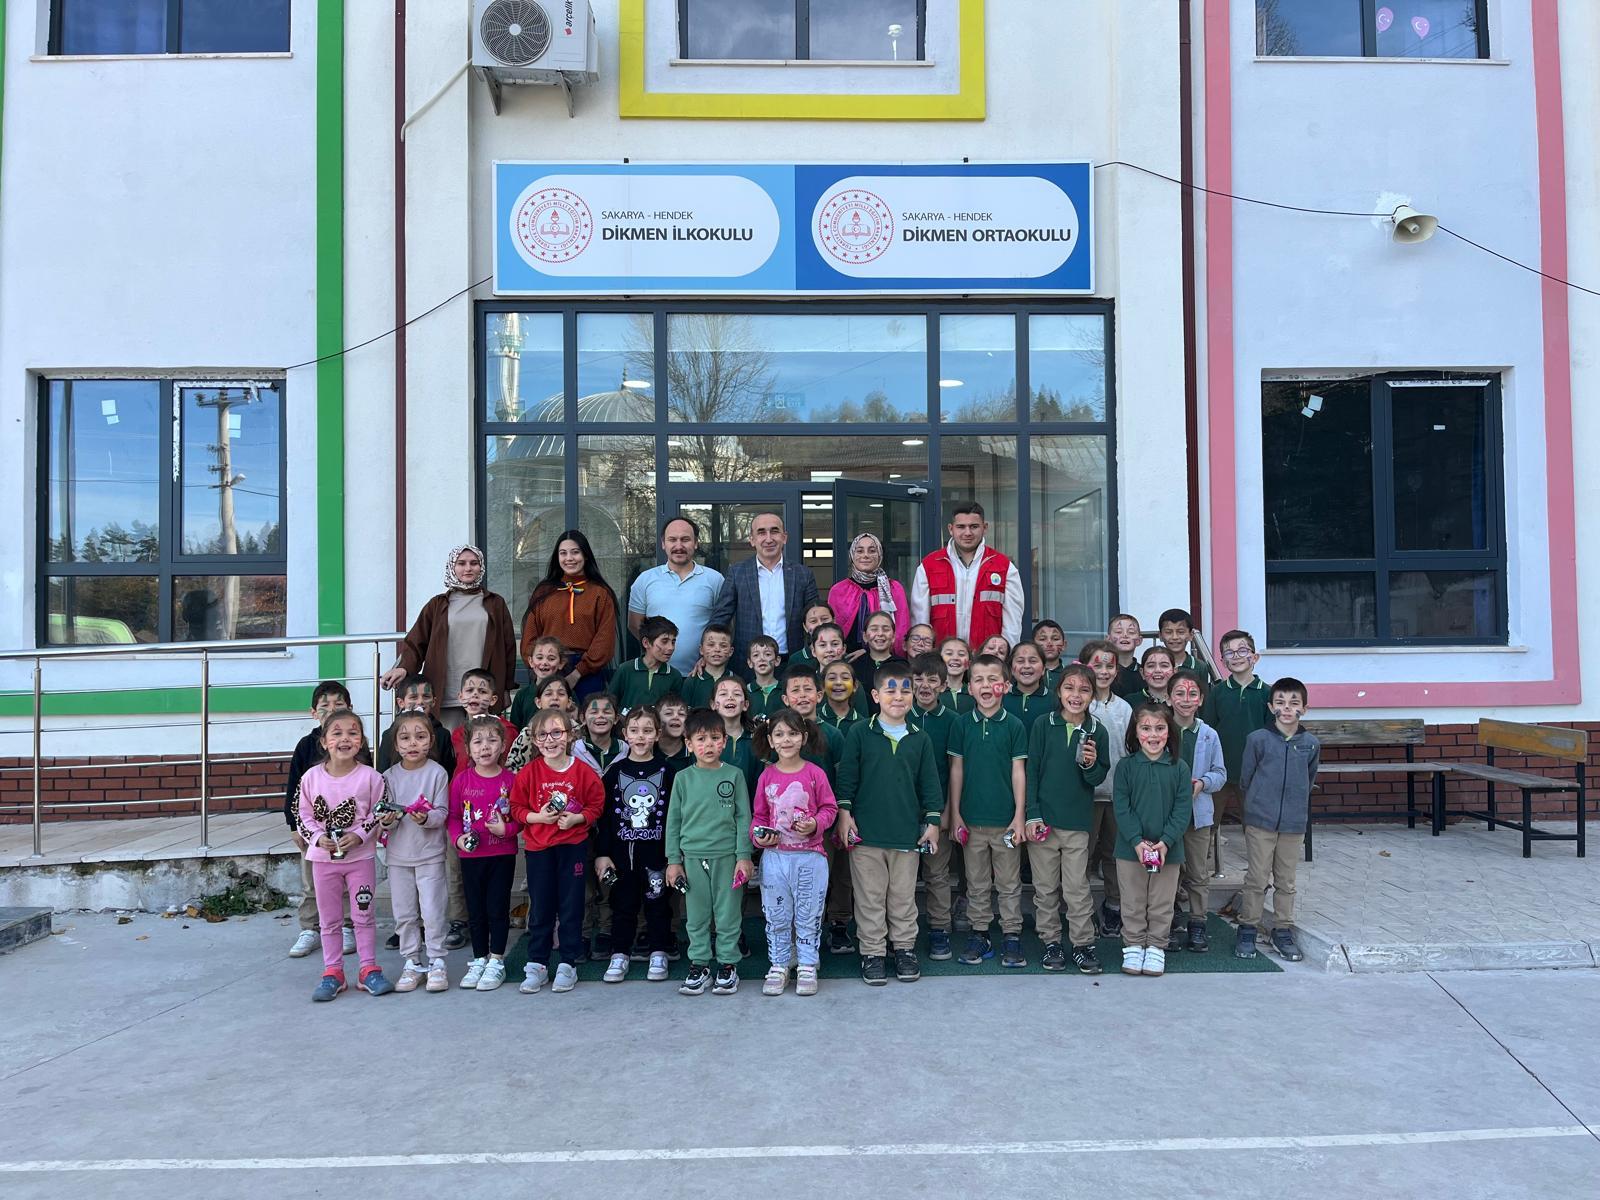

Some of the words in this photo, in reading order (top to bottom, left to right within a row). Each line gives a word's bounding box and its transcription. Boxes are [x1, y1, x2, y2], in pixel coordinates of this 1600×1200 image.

[602, 211, 645, 220] SAKARYA
[653, 211, 693, 220] HENDEK
[902, 212, 945, 221] SAKARYA
[953, 212, 993, 221] HENDEK
[602, 225, 667, 241] DİKMEN
[673, 225, 753, 241] İLKOKULU
[903, 226, 968, 242] DİKMEN
[972, 229, 1071, 242] ORTAOKULU
